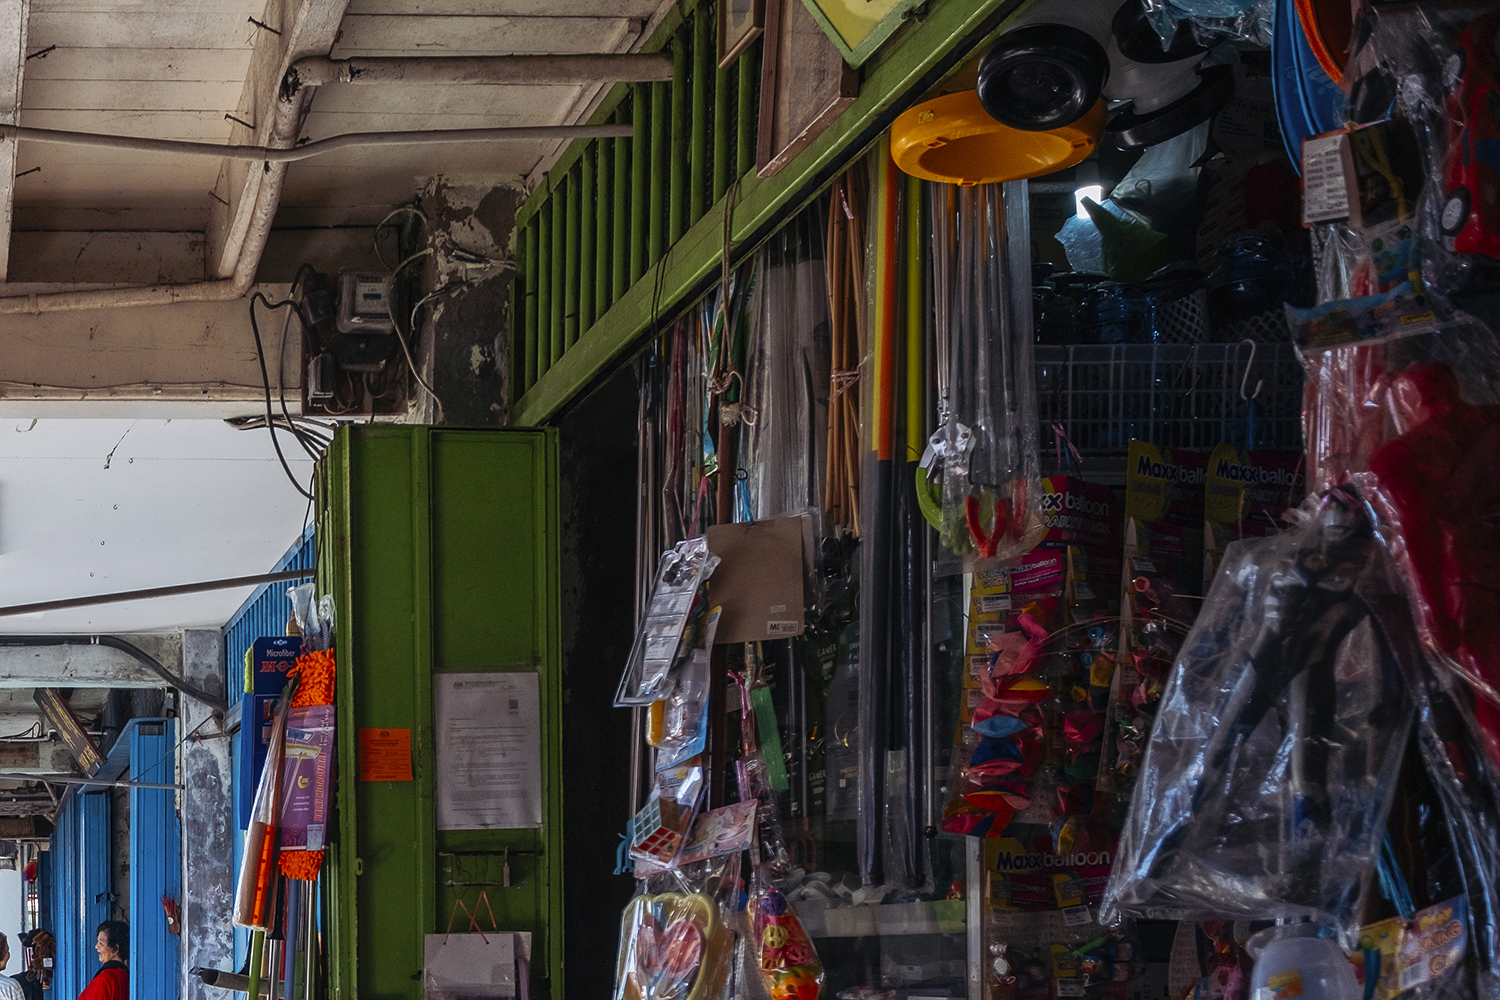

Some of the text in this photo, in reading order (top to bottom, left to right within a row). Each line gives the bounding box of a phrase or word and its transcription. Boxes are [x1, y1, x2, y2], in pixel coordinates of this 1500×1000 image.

[1137, 455, 1208, 485] Maxx ball
[1216, 457, 1304, 487] Maxx balloo
[1064, 491, 1110, 517] balloon
[1032, 558, 1057, 569] balloon
[266, 649, 296, 658] Microfiber
[817, 643, 837, 657] GAMER
[809, 769, 827, 781] GAMER
[313, 752, 327, 822] BALAI MICROFIBRE
[996, 850, 1111, 871] Maxx balloon
